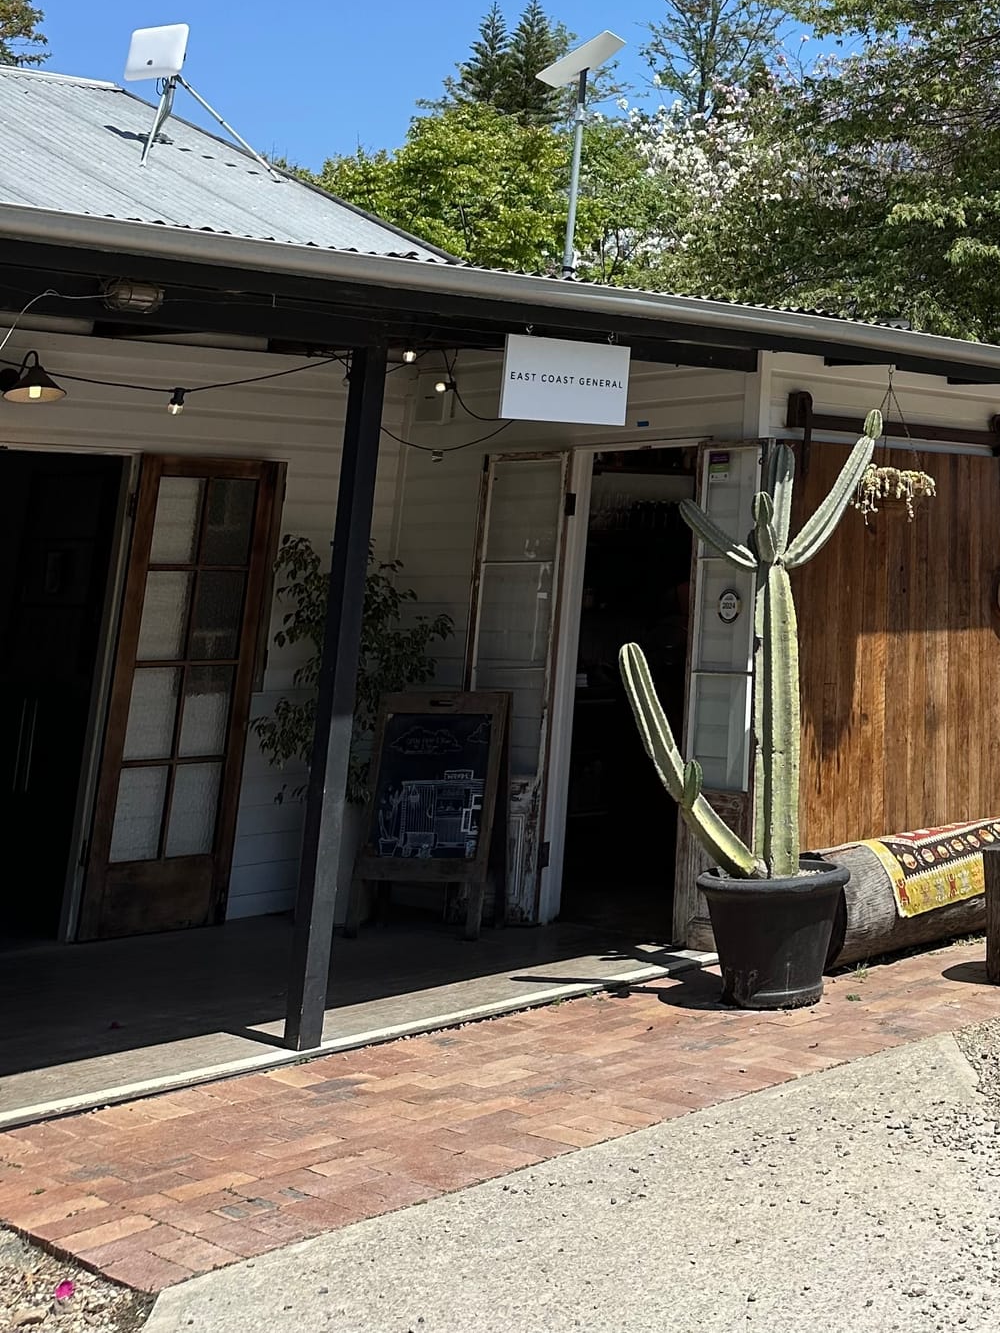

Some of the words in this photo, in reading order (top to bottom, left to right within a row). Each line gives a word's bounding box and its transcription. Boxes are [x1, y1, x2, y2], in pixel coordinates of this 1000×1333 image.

[510, 371, 537, 382] EAST
[541, 374, 575, 385] COAST
[578, 377, 623, 389] GENERAL
